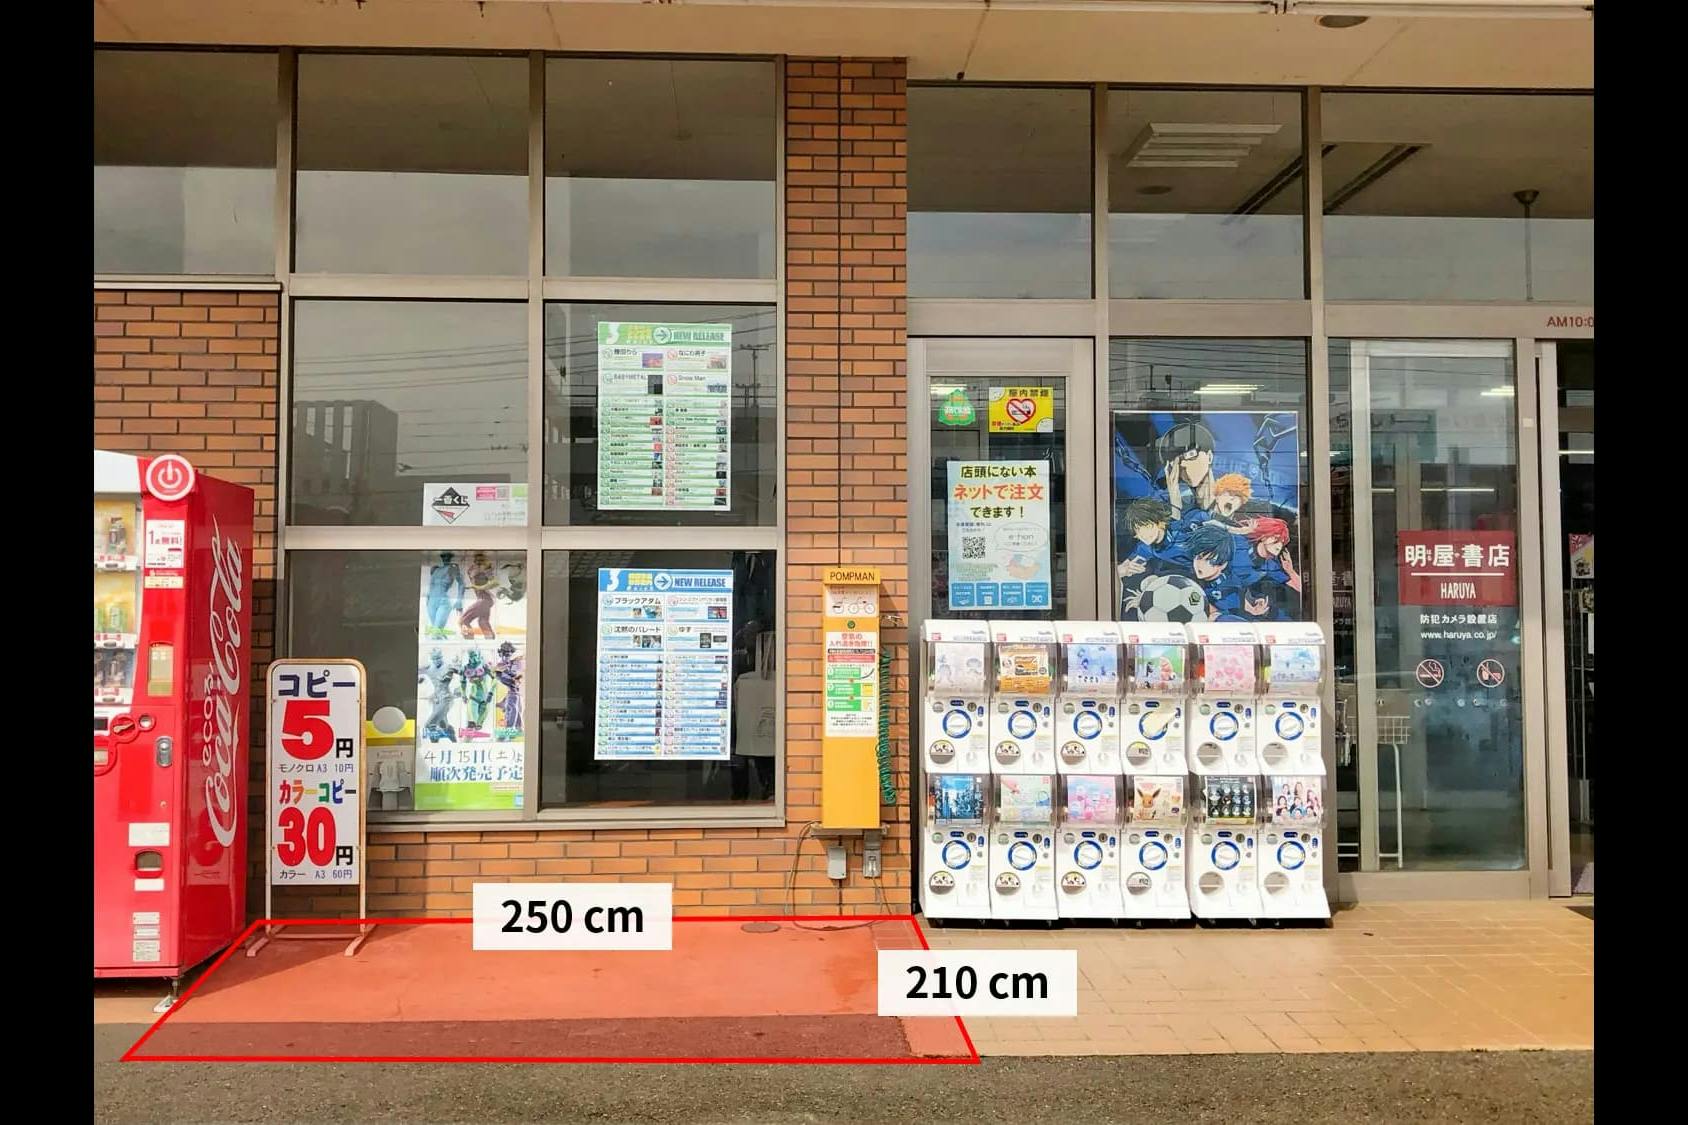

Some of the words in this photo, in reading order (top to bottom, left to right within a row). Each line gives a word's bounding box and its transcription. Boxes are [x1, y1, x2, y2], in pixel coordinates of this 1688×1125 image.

[960, 465, 1037, 479] 店頭にない本
[953, 484, 1044, 501] ネットで注文
[1404, 543, 1511, 568] 明屋書店
[674, 577, 692, 587] NEW
[693, 577, 727, 588] RELEASE
[829, 571, 876, 581] POMPMAN
[1440, 582, 1477, 599] HARUYA
[614, 597, 661, 605] ブラックアダム
[1419, 614, 1498, 625] 防犯カメラ設置店
[278, 669, 356, 698] コピー
[279, 763, 314, 773] モノクロ
[317, 763, 328, 773] A3
[335, 763, 354, 773] 10円
[278, 779, 357, 805] カラーコピー
[277, 806, 354, 867] 30円
[279, 869, 306, 879] カラー
[315, 869, 326, 878] A3
[332, 869, 353, 879] 60円
